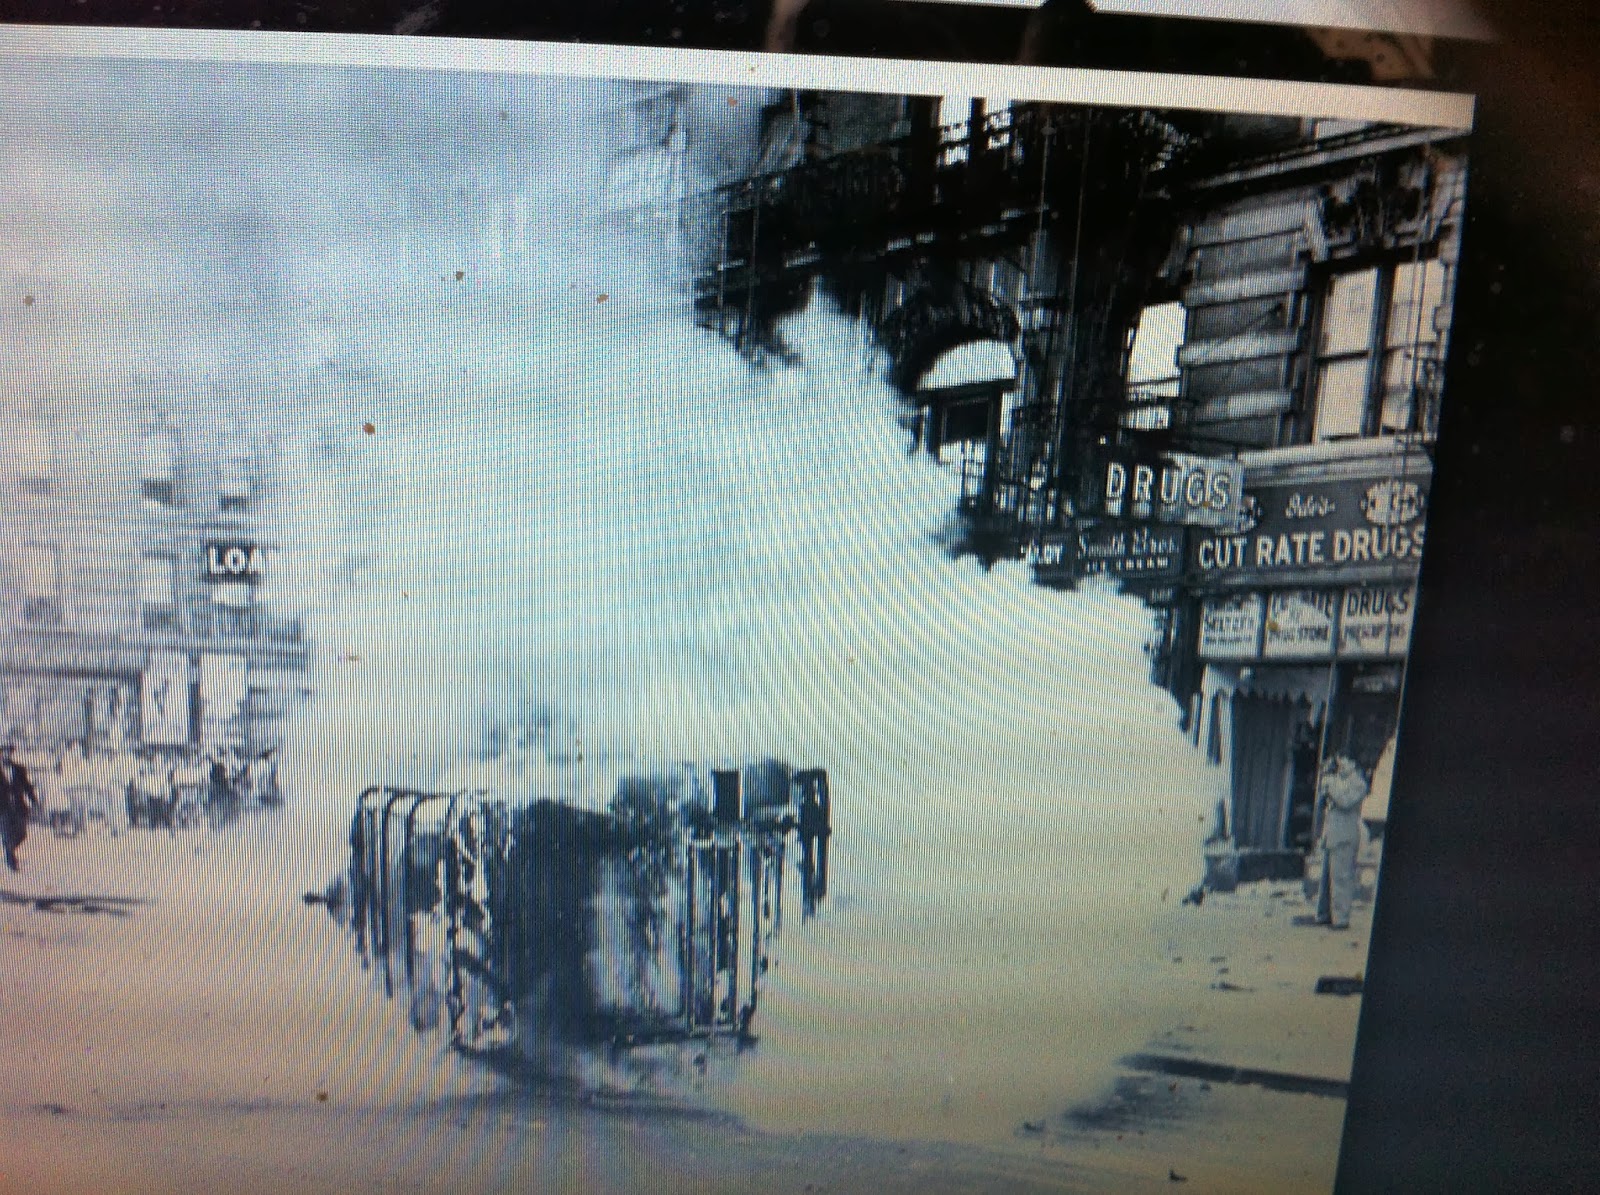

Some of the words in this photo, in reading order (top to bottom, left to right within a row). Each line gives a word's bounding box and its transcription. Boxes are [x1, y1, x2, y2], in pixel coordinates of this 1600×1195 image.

[1106, 461, 1230, 509] DRUGS
[1199, 536, 1247, 569] CUT
[1256, 531, 1325, 566] RATE
[1333, 523, 1426, 562] DRUGS
[1346, 588, 1409, 618] DRUGS
